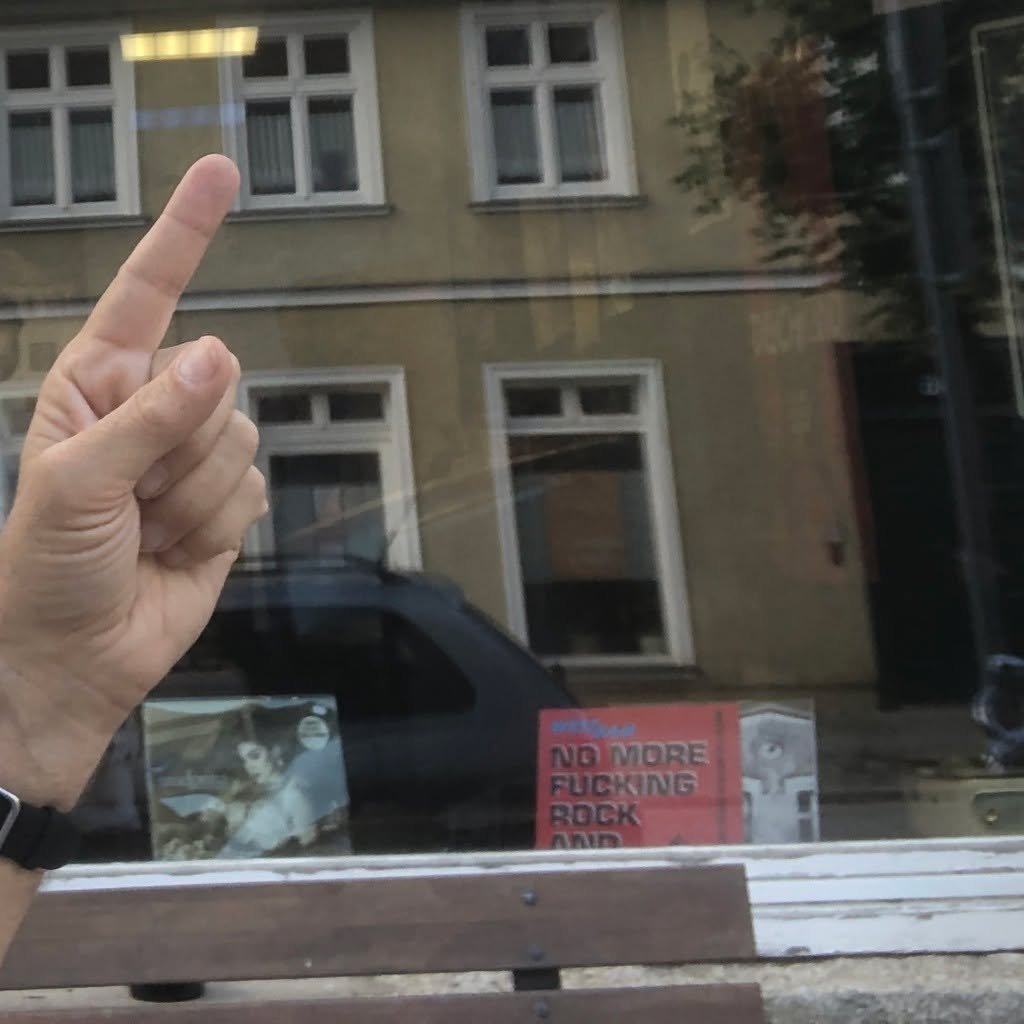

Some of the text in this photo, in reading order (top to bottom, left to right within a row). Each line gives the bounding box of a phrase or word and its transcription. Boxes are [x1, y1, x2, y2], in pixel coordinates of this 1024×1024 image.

[550, 740, 709, 768] NO MORE
[550, 770, 697, 797] FUCKING
[549, 800, 640, 827] ROCK
